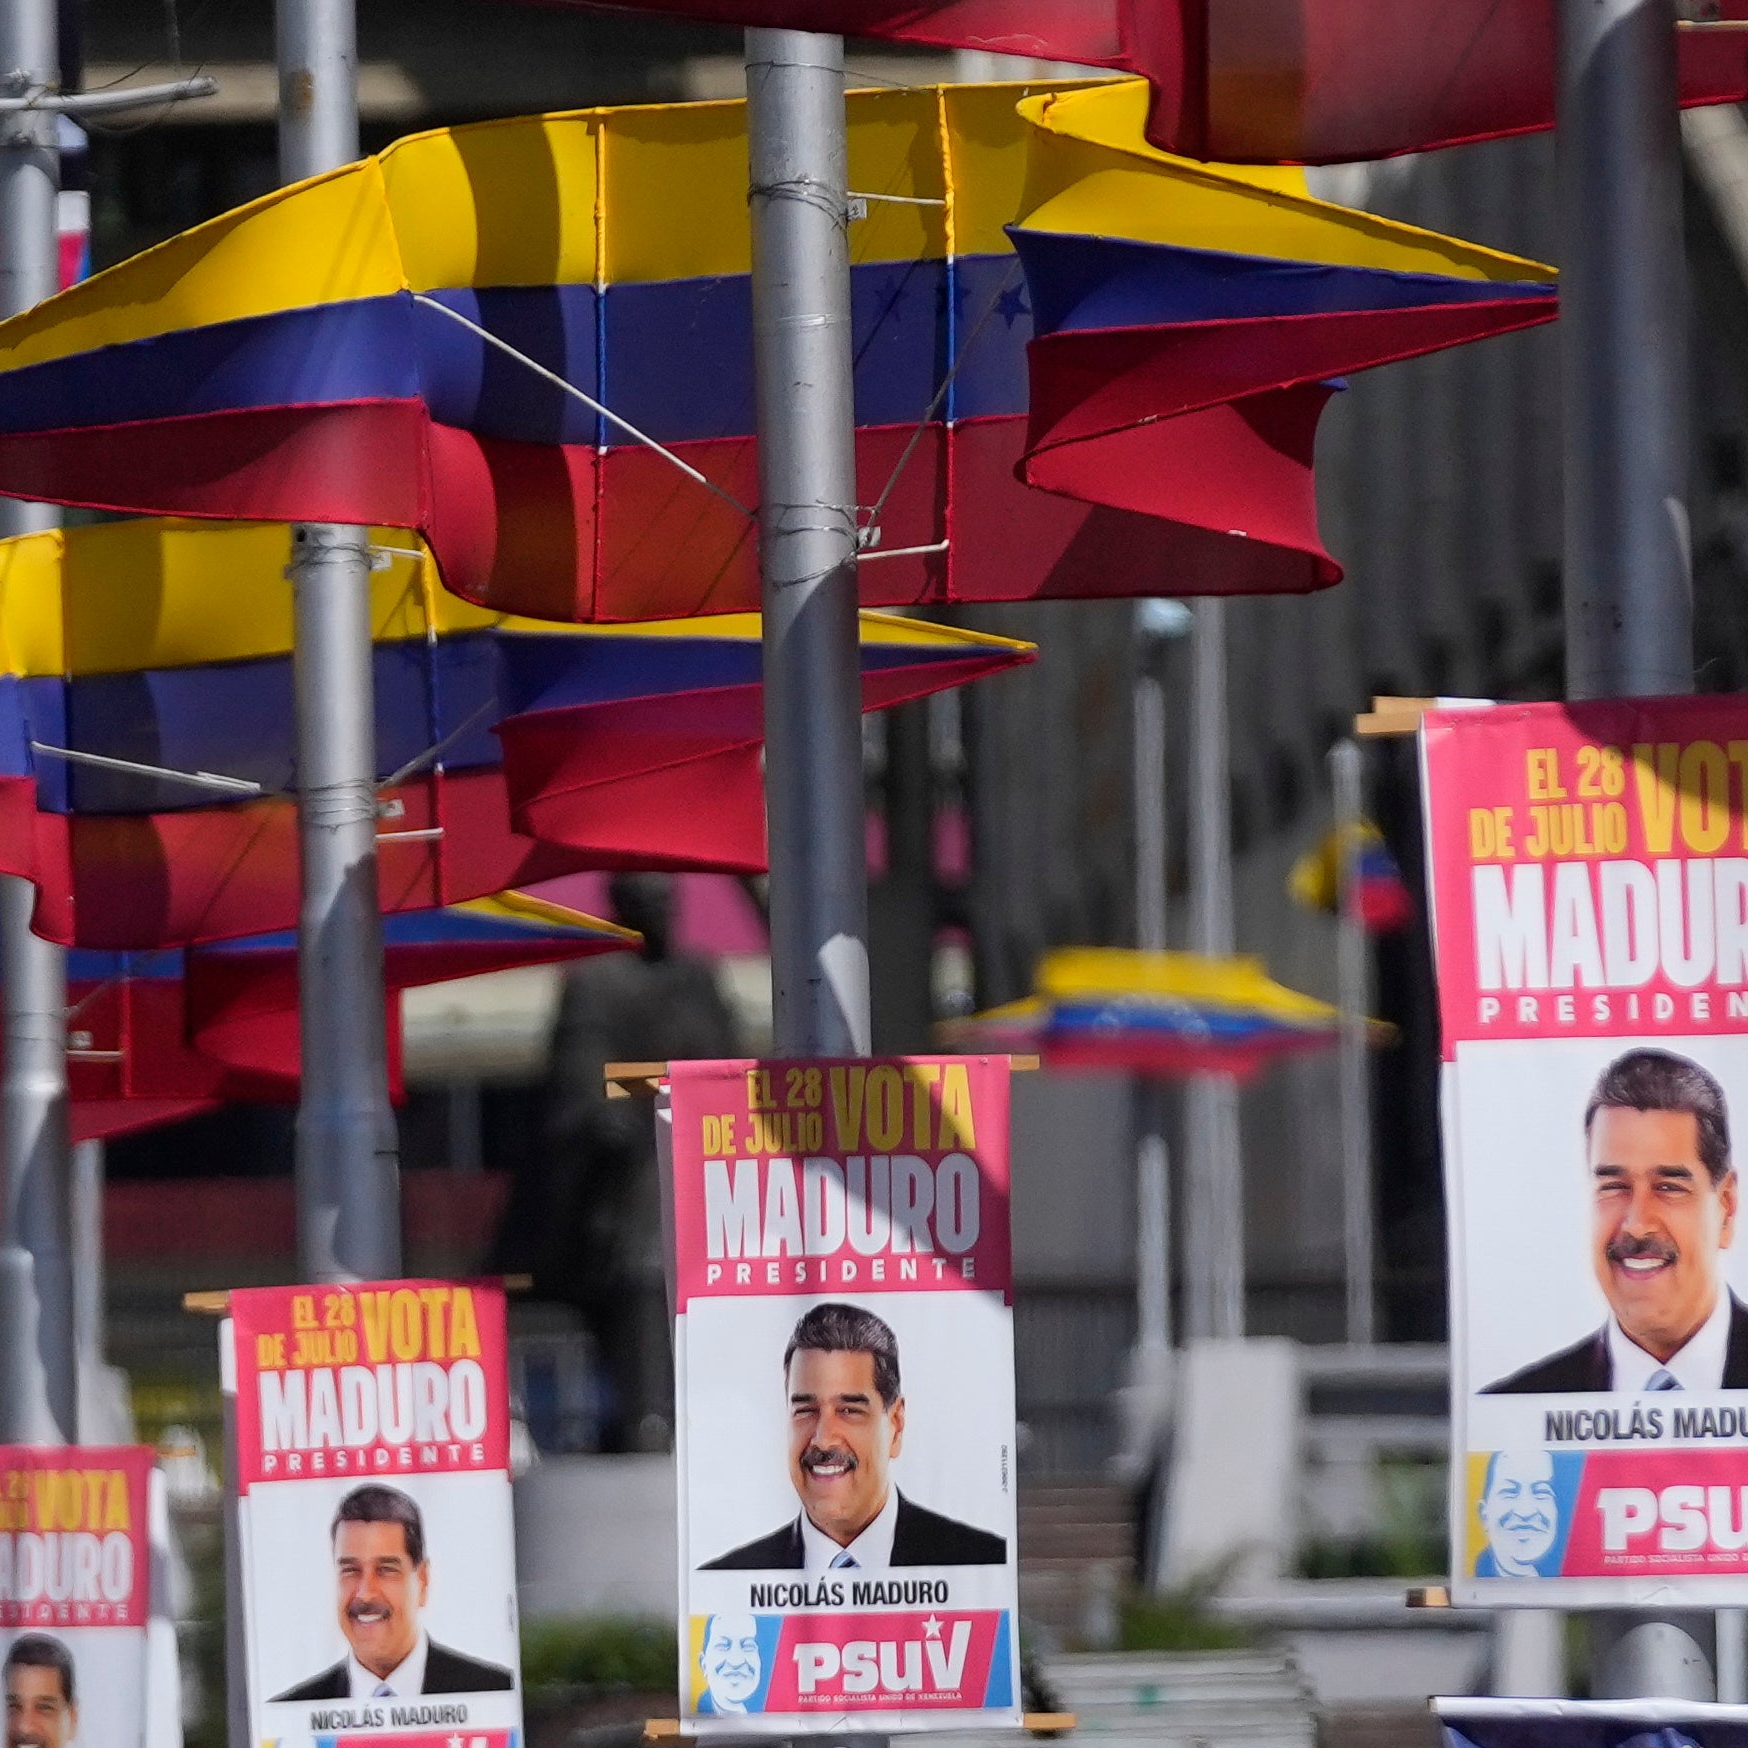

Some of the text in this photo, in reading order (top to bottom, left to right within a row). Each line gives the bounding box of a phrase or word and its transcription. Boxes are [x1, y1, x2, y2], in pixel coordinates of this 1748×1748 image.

[1526, 747, 1566, 800] EL
[1577, 745, 1626, 797] 28
[1469, 800, 1628, 859] DE JULIO
[746, 1063, 977, 1151] EL 28 VOTA
[702, 1110, 824, 1157] DE JULIO
[704, 1152, 981, 1260] MADURO
[706, 1256, 977, 1287] PRESIDENTE
[358, 1286, 483, 1363] VOTA
[259, 1358, 488, 1451] MADURO
[1544, 1401, 1664, 1442] NICOLÁS
[262, 1443, 486, 1474] PRESIDENTE
[750, 1575, 950, 1609] NICOLÁS MADURO
[309, 1703, 469, 1731] NICOLÁS MADURO
